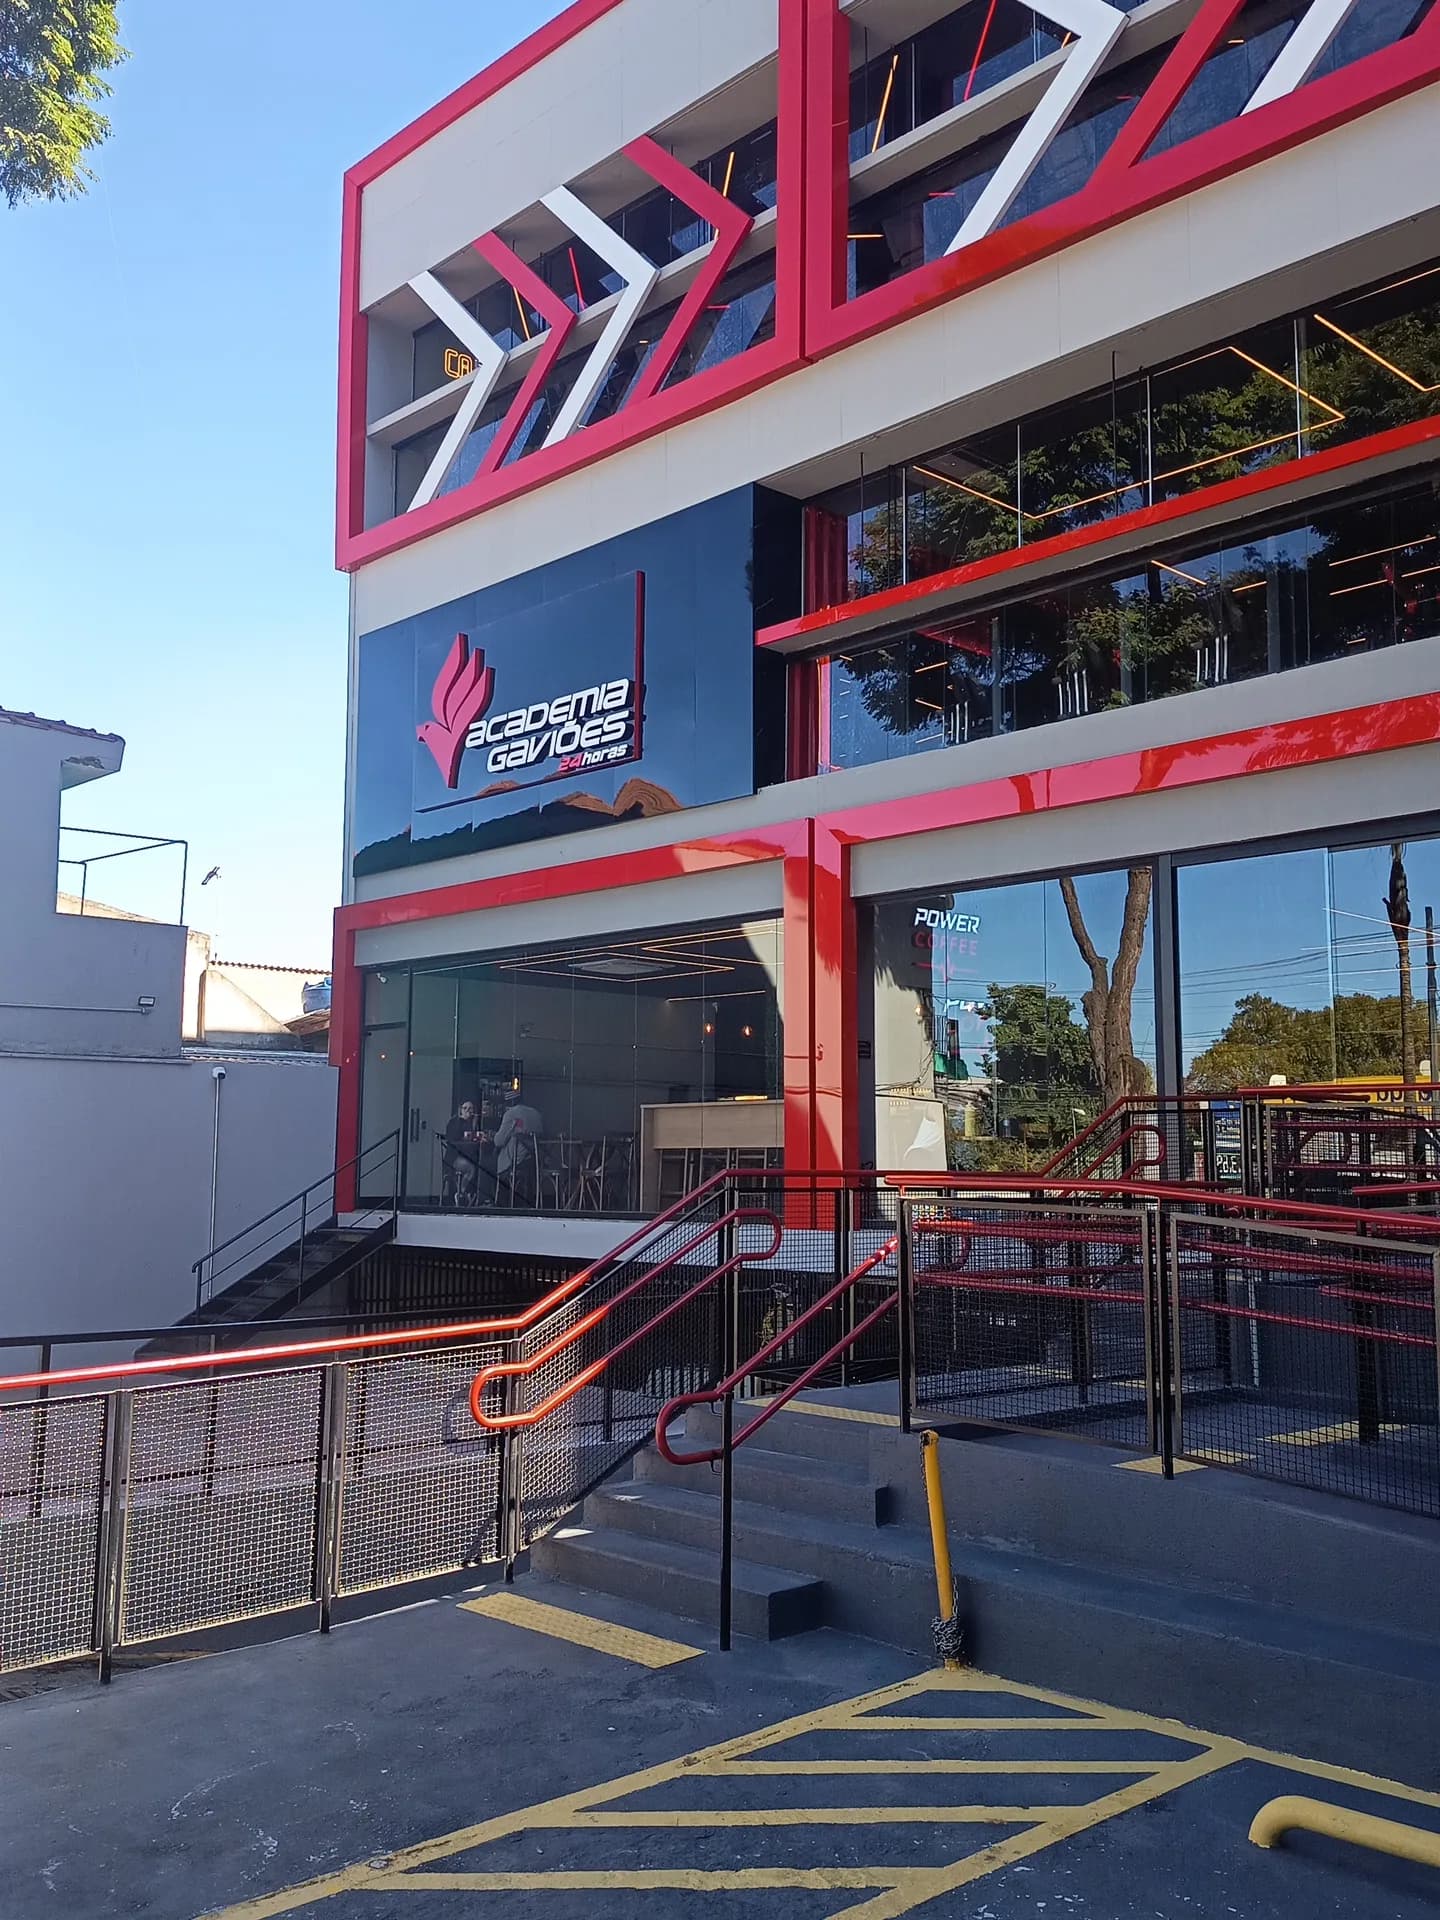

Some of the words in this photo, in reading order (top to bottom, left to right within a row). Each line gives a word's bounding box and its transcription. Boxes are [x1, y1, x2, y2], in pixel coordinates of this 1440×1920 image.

[465, 678, 630, 748] ACADEMIA
[487, 710, 630, 773] GAVIÕES
[914, 907, 980, 934] POWER
[914, 931, 978, 956] COFFEE
